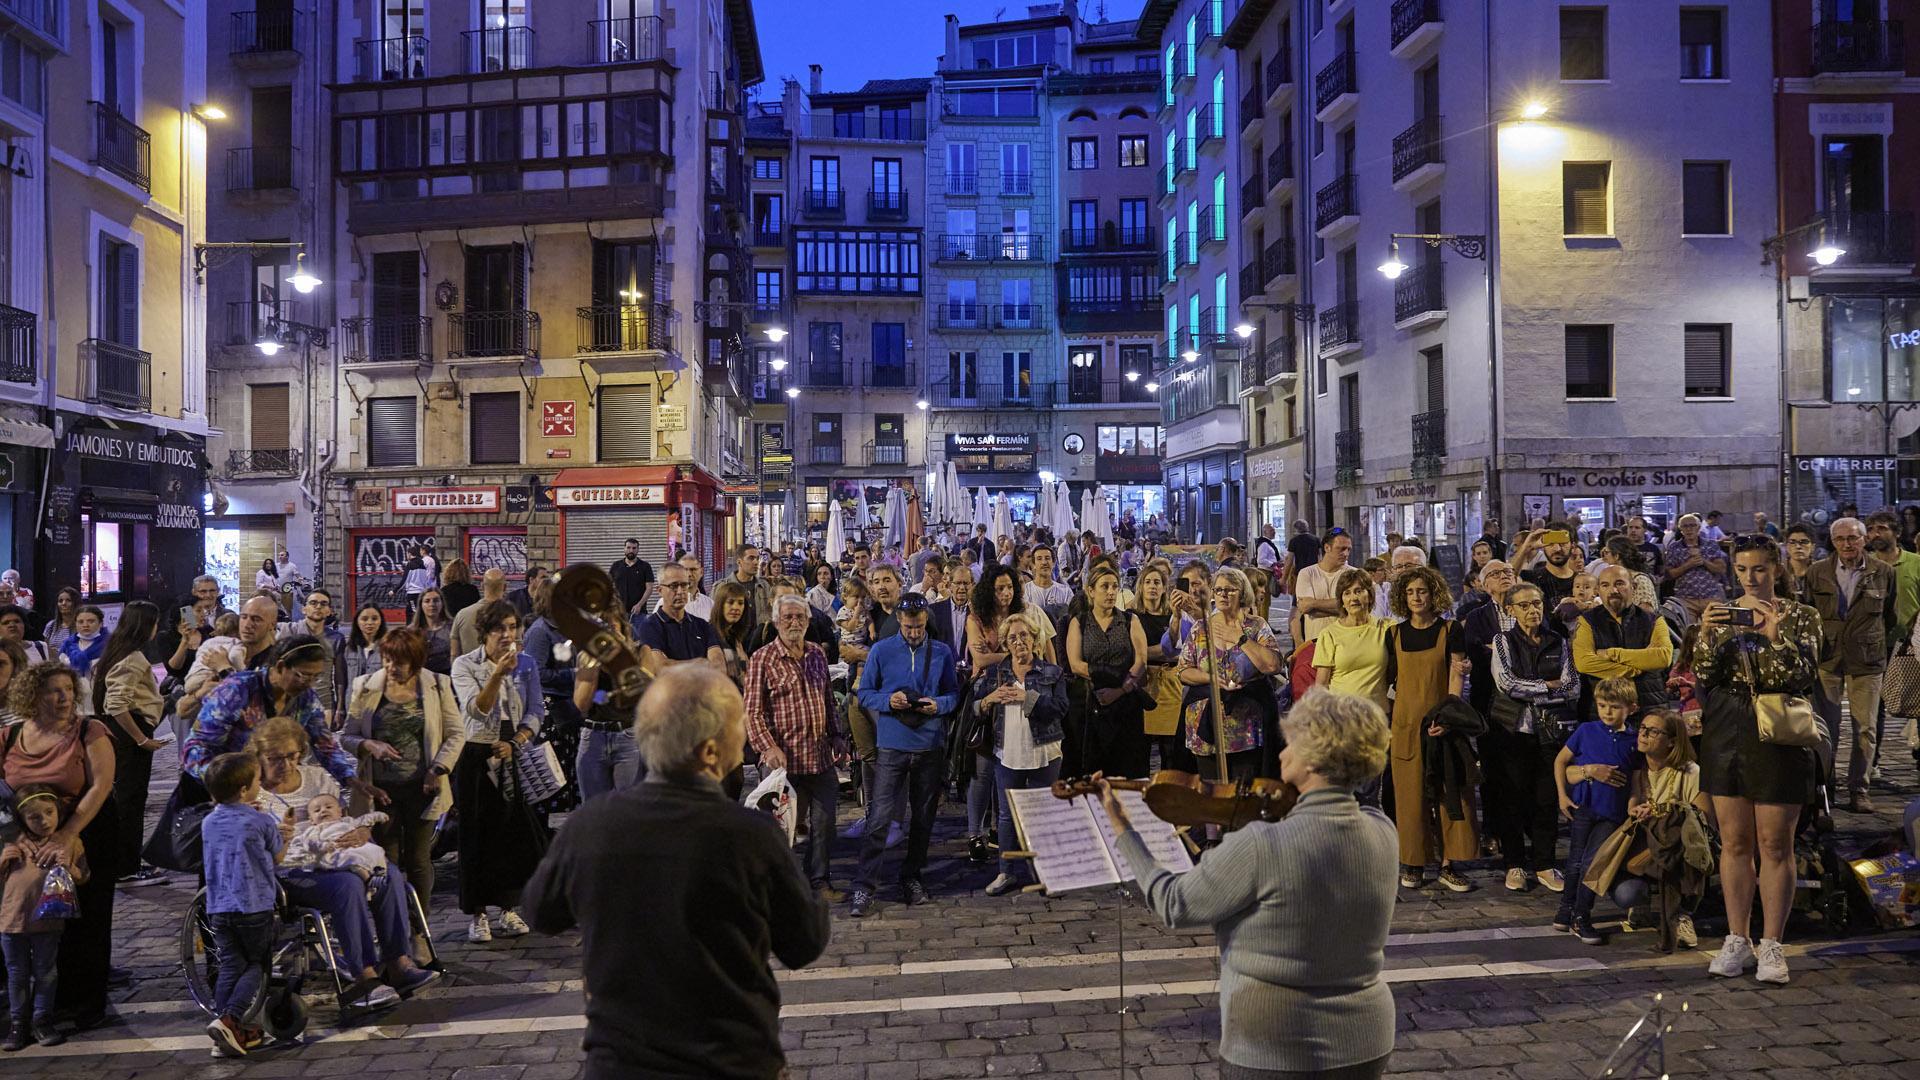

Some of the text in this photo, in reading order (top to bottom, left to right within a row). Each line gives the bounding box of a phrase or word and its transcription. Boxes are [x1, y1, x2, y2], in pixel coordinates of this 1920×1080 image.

[977, 434, 995, 445] SAN
[66, 432, 194, 468] JAMONES Y EMBUTIDOS
[1798, 459, 1896, 471] GUTIERREZ
[1541, 470, 1698, 490] The Cookie Shop
[571, 487, 650, 502] GUTIERREZ
[1374, 481, 1437, 500] The Cookie Shop
[409, 493, 484, 506] GUTIERREZ
[156, 514, 201, 529] SALAMANCA
